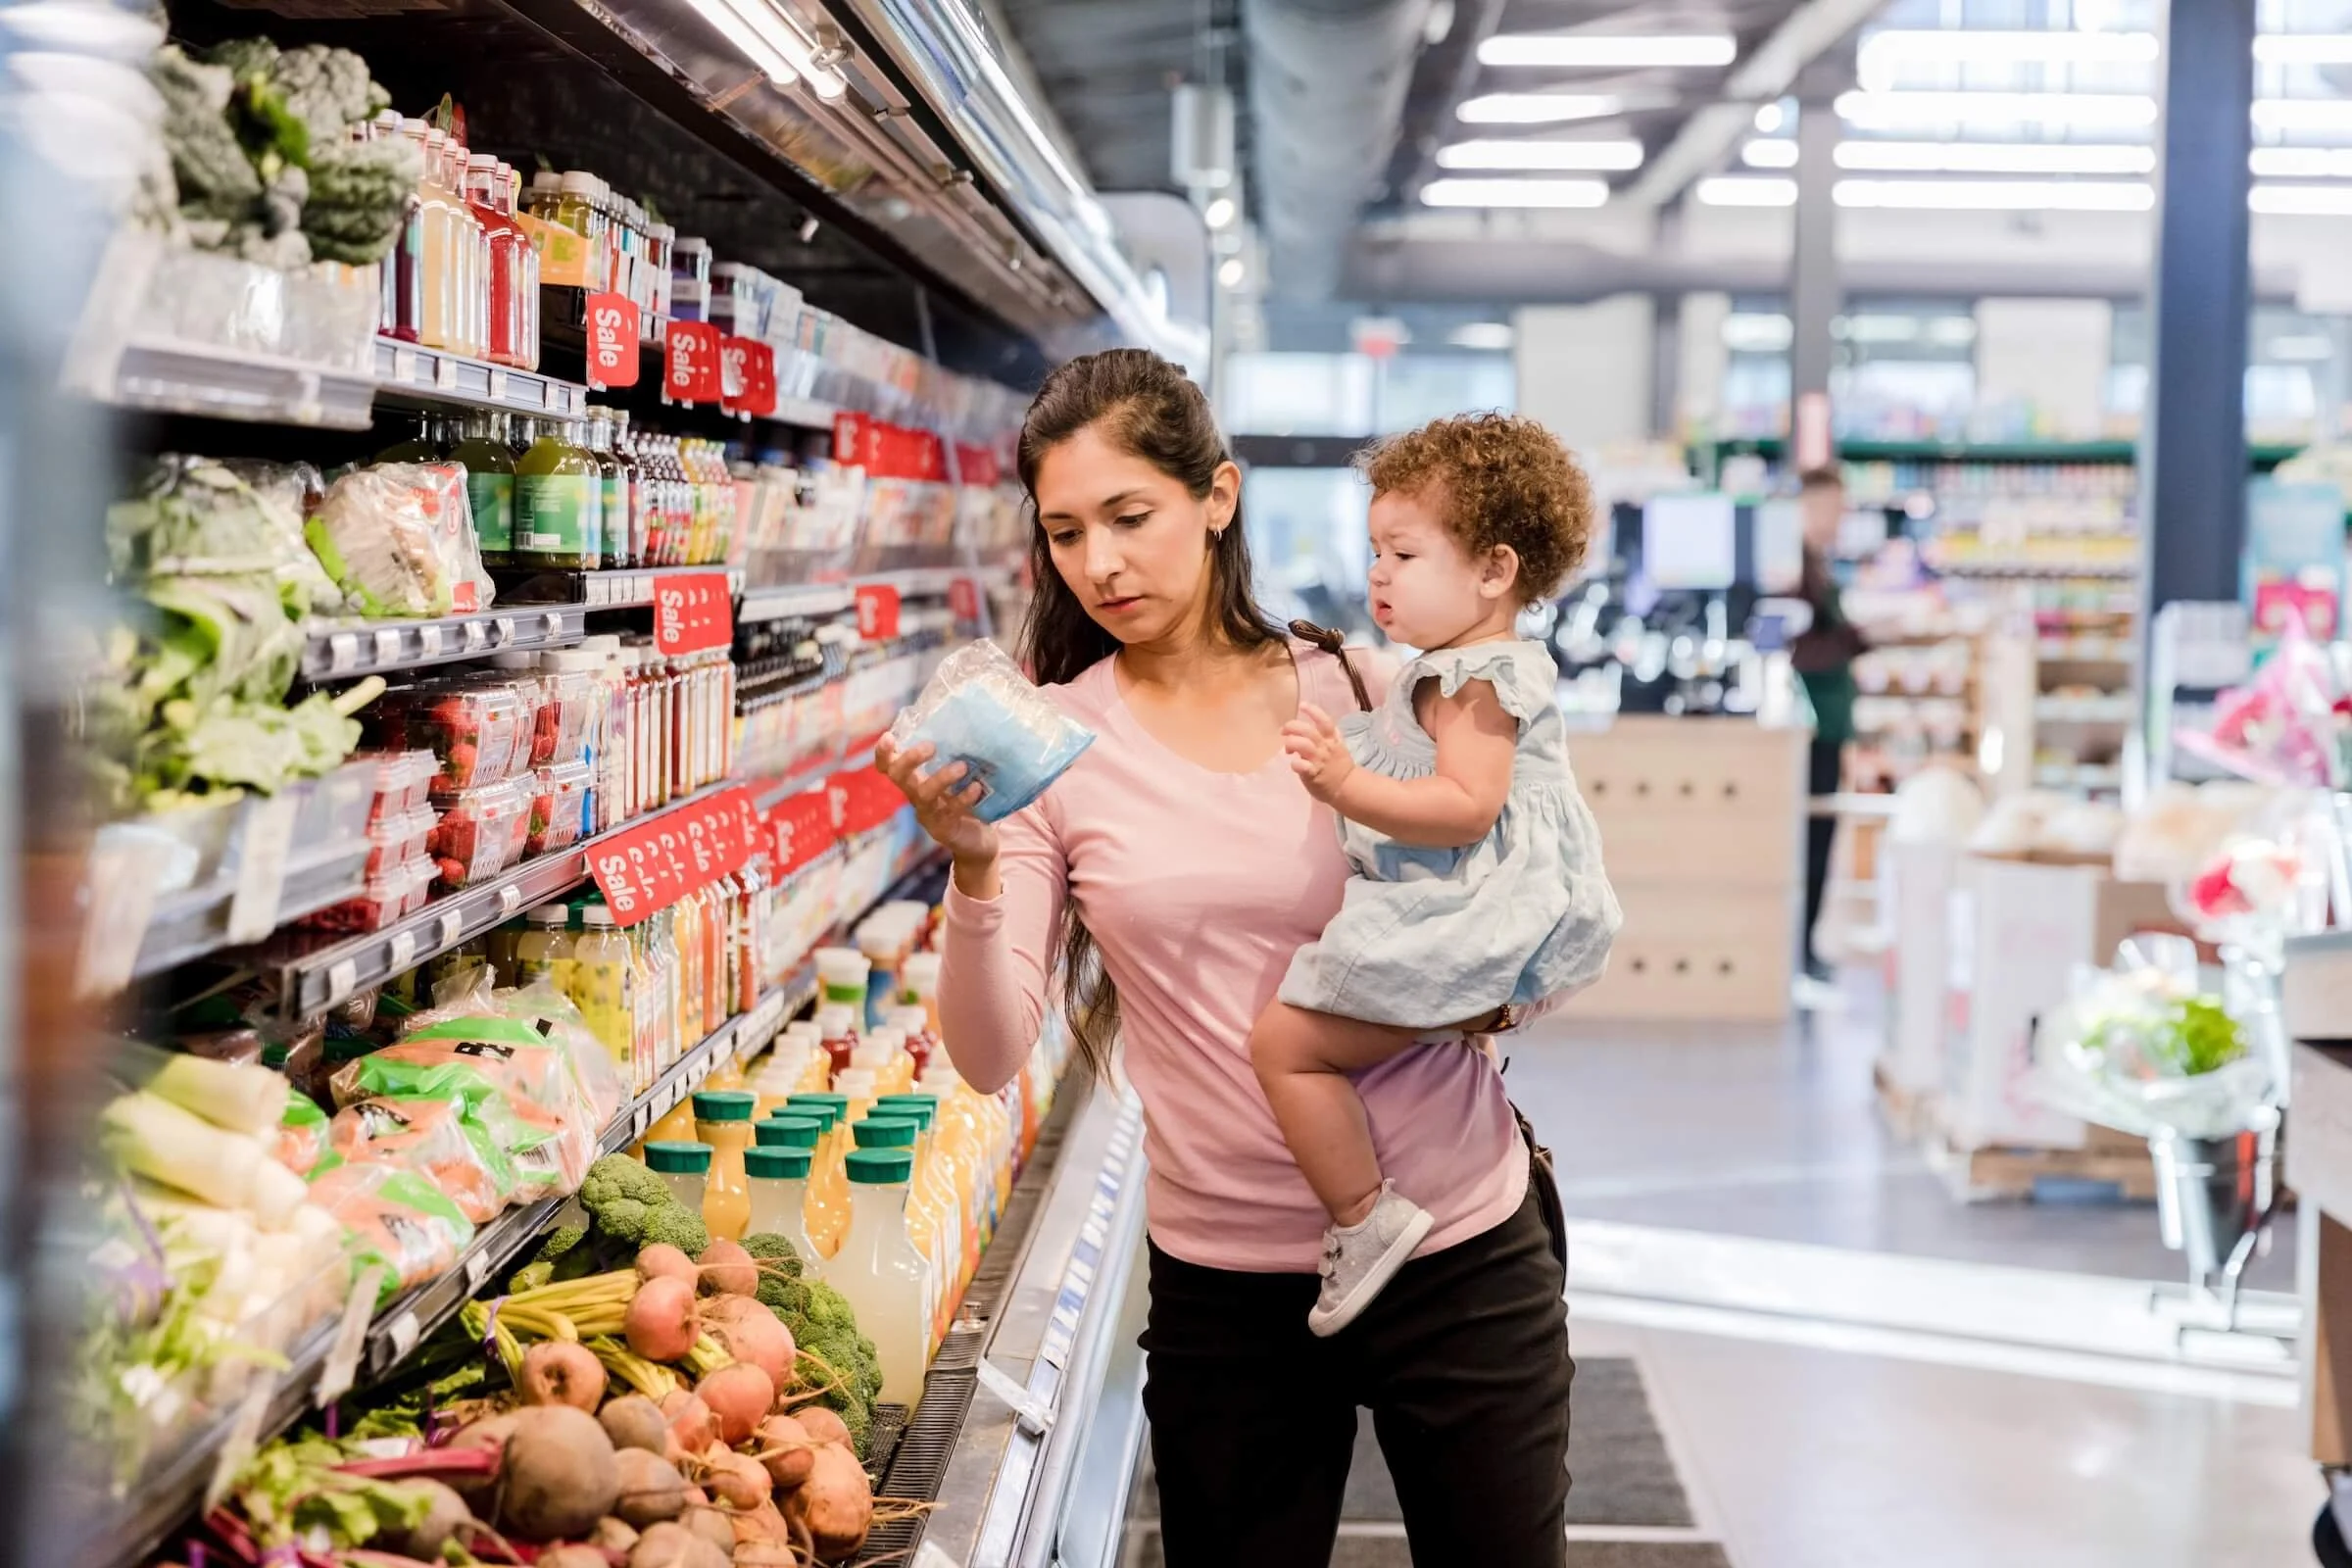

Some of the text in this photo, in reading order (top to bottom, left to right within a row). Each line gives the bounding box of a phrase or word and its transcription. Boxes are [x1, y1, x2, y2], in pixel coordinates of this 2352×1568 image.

[595, 307, 624, 368] Sale
[672, 332, 697, 387] Sale
[660, 589, 686, 644] Sale
[599, 855, 637, 911] Sale
